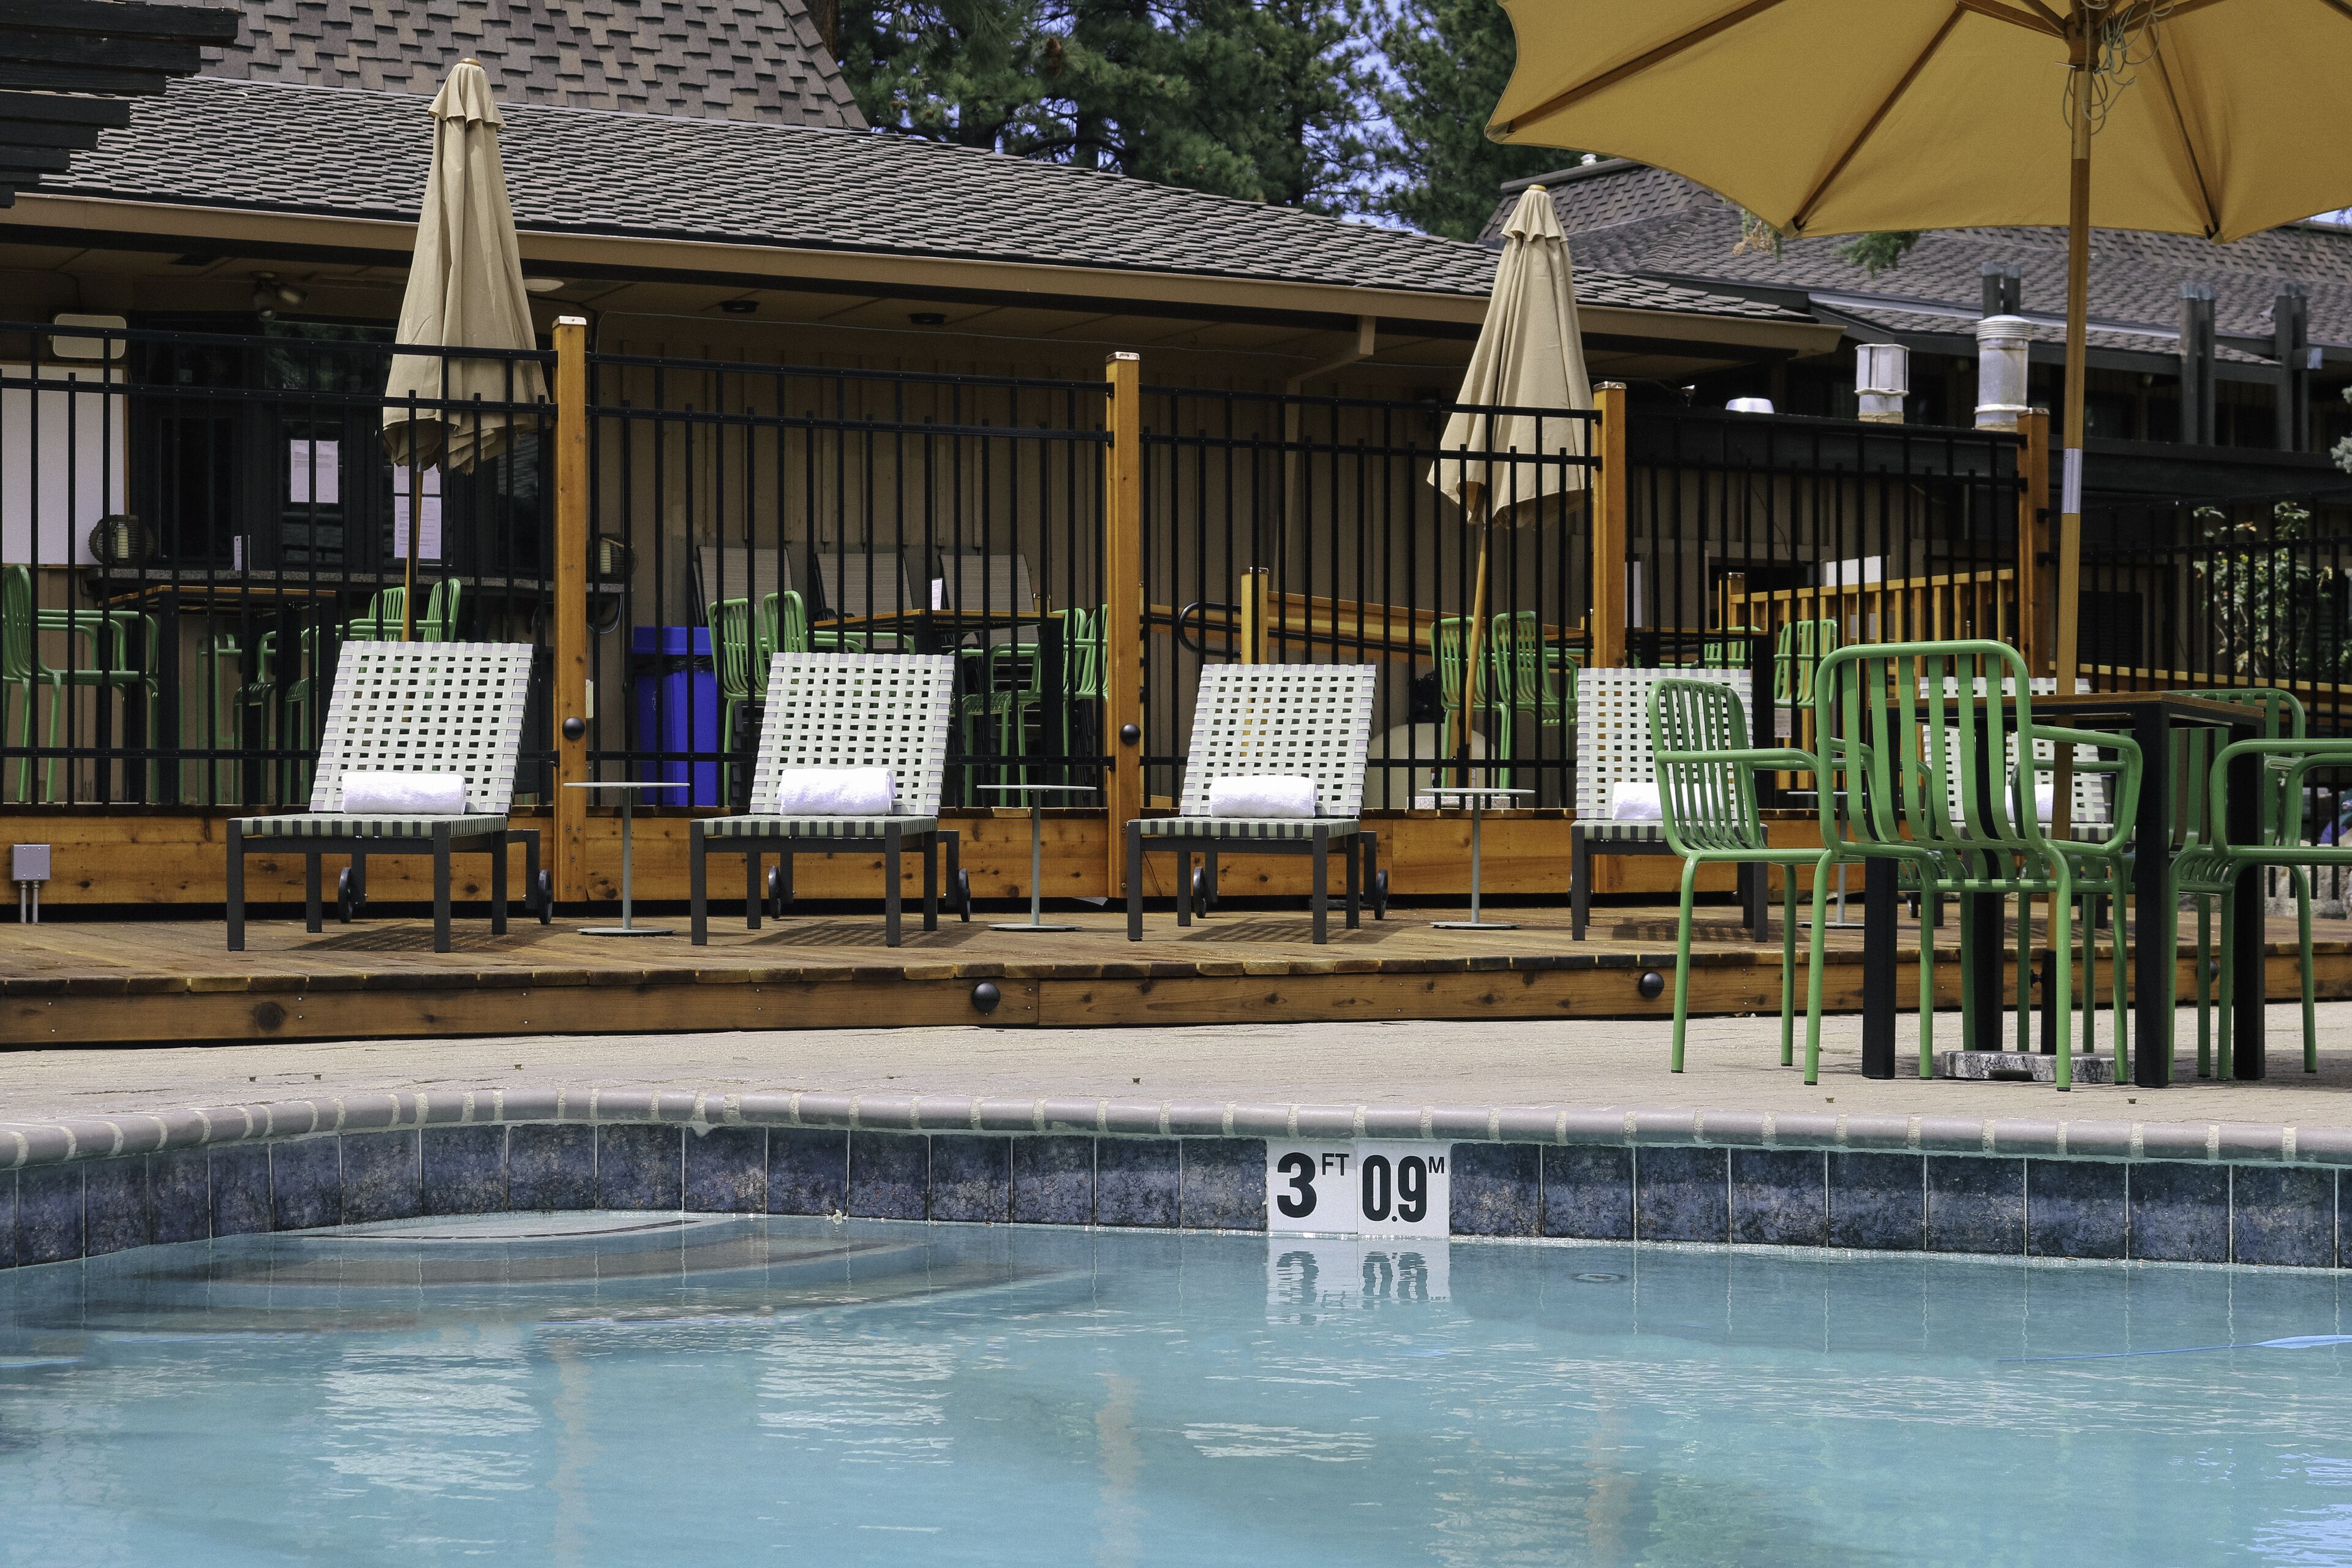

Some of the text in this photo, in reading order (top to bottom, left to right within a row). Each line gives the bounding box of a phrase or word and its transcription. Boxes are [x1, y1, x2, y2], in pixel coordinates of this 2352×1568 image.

[1276, 1152, 1445, 1223] 3 FT 0.9 M
